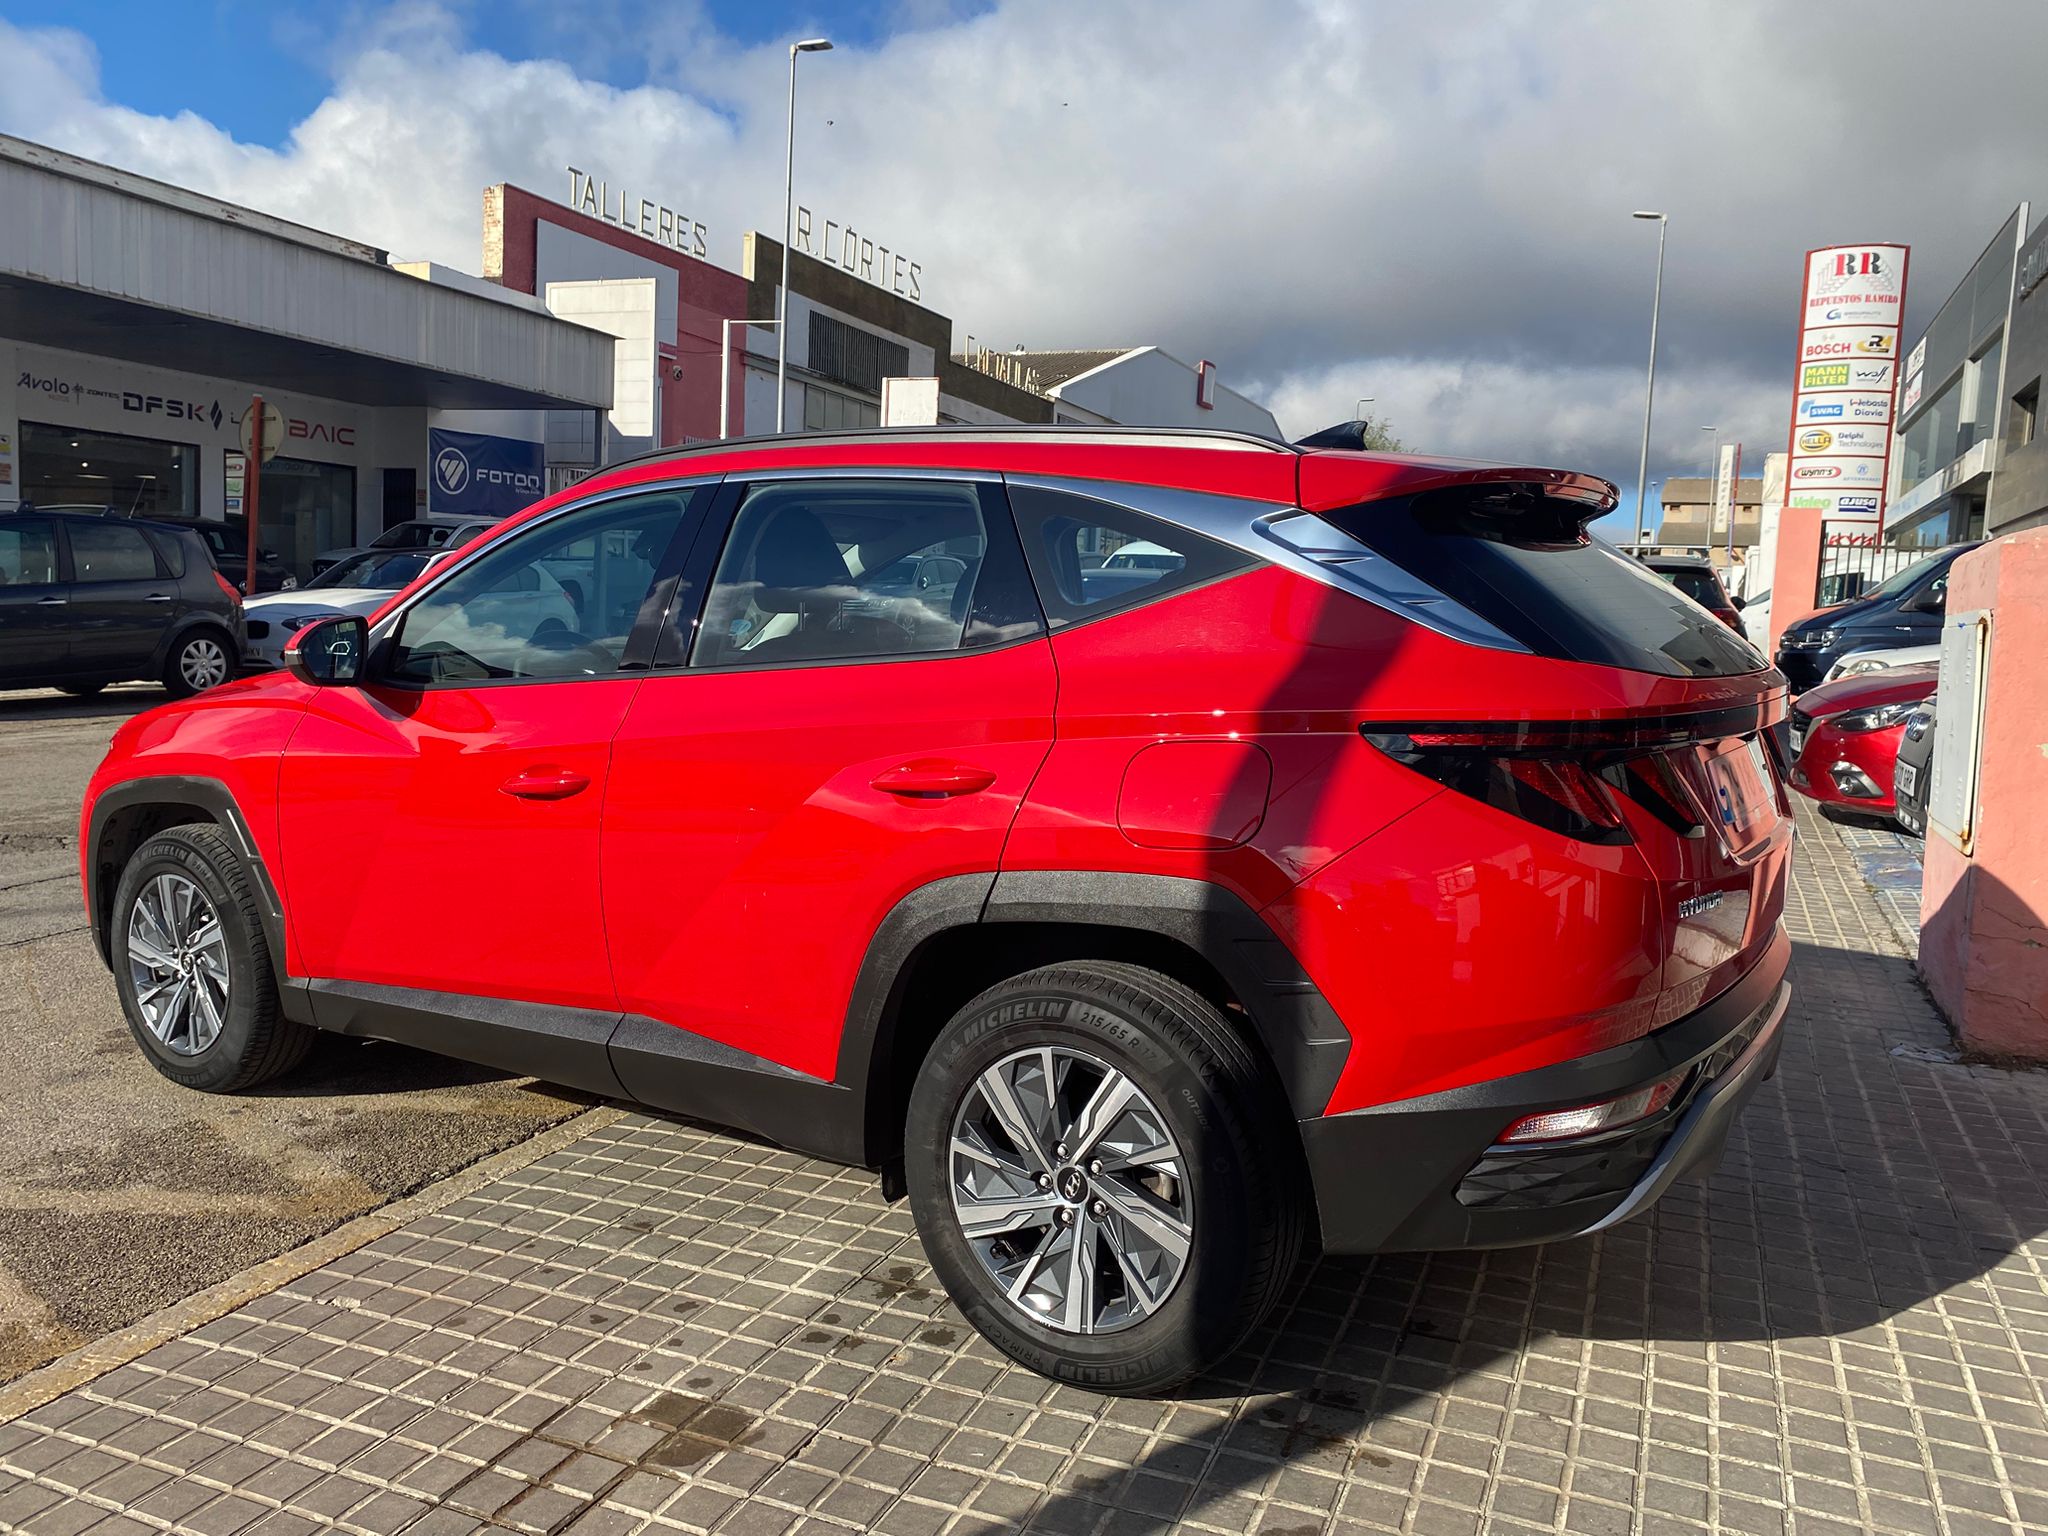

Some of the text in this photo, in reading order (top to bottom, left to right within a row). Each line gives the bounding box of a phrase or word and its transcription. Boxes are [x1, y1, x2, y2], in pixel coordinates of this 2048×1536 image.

[567, 165, 707, 258] TALLERES
[1809, 293, 1898, 307] REPUESTOS RAMIRO
[1806, 342, 1852, 356] BOSCH
[1806, 366, 1848, 377] MANN
[1804, 375, 1847, 387] FILTER
[122, 391, 205, 422] DFSK
[1811, 406, 1841, 416] SWAG
[1854, 408, 1884, 417] Diavia
[288, 418, 355, 446] BAIC
[1838, 432, 1864, 440] Delphi
[1801, 436, 1832, 445] HELLA
[1838, 440, 1884, 449] Technologies
[476, 468, 540, 488] FOTON
[140, 844, 188, 861] MICHELIN
[1678, 889, 1724, 919] HYUNDAI
[962, 1000, 1066, 1046] MICHELIN
[1079, 1012, 1127, 1040] 215/65
[1127, 1036, 1140, 1050] R
[981, 1323, 1042, 1366] PRIMACY
[1056, 1349, 1173, 1385] MICHELIN
